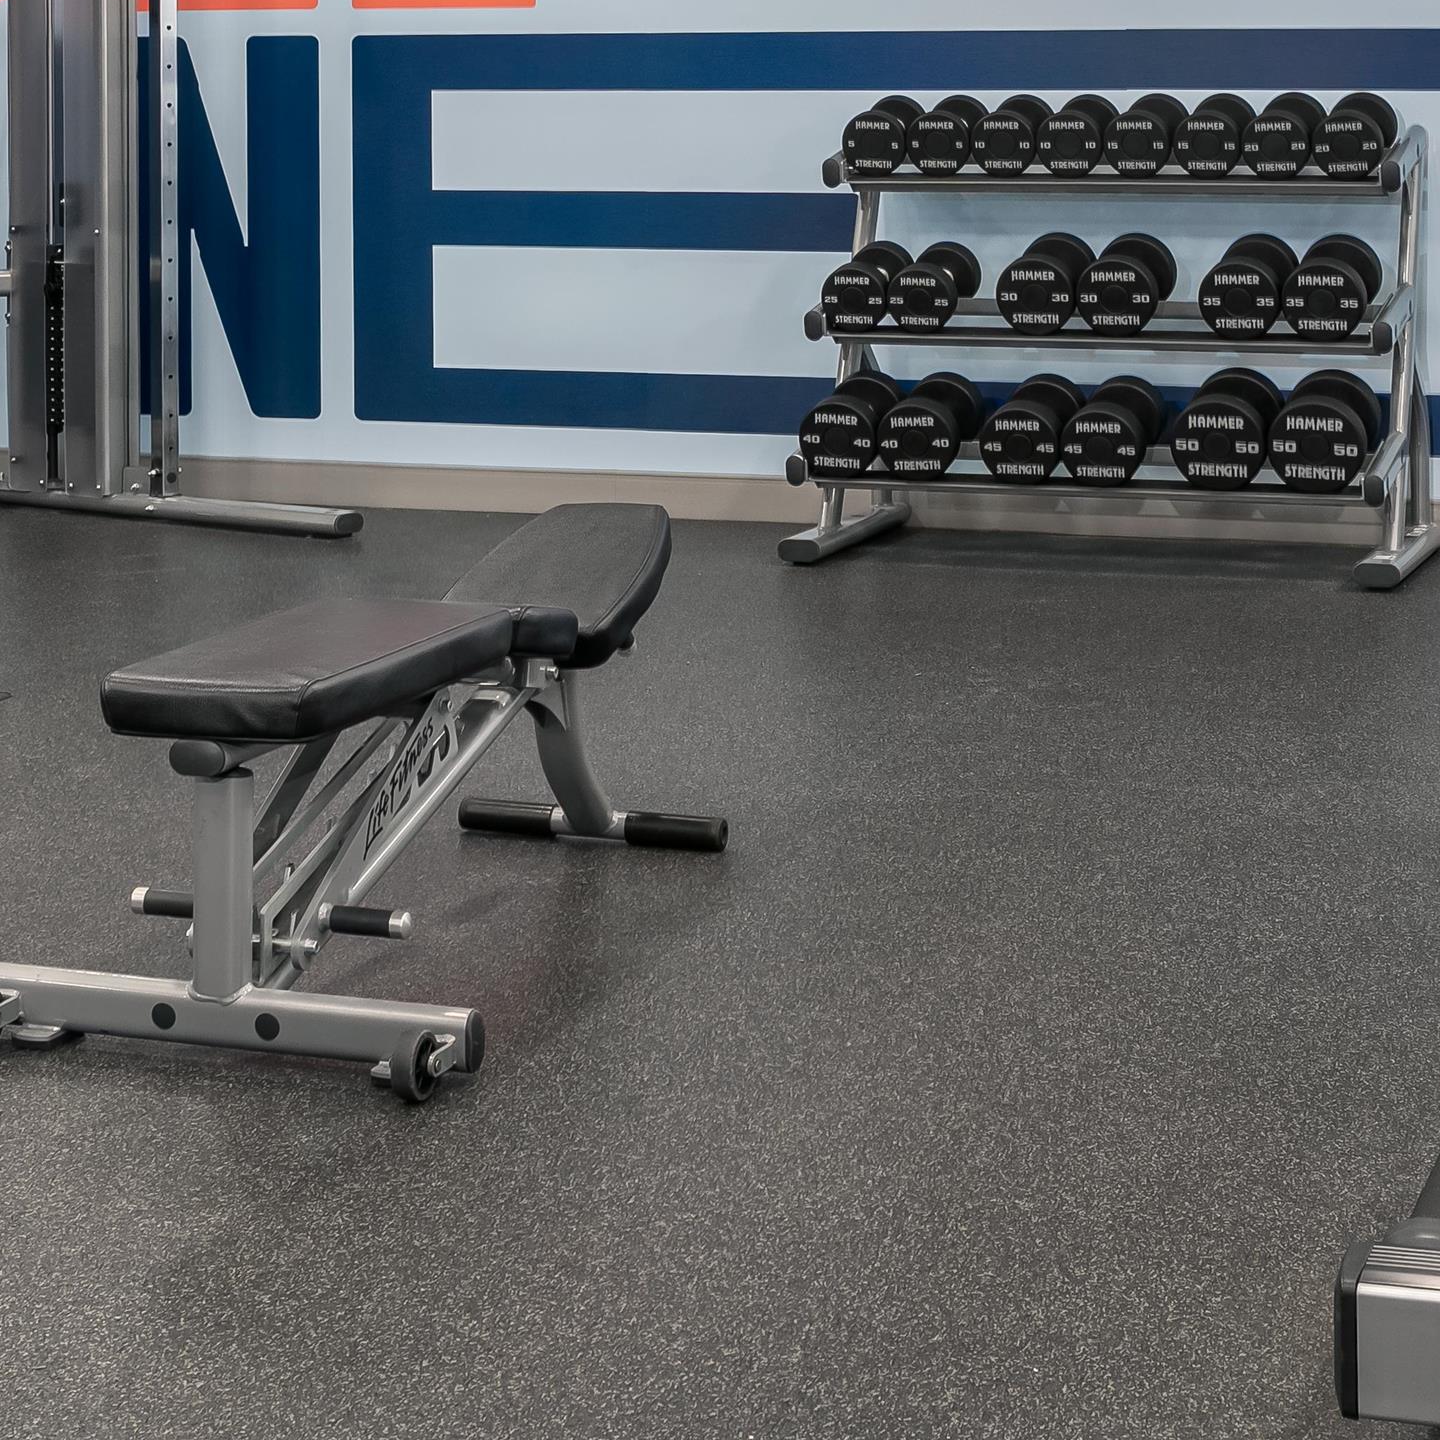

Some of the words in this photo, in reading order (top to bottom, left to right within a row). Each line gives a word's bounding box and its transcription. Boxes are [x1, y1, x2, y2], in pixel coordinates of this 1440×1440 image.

[855, 120, 890, 130] HAMMER
[918, 121, 954, 131] HAMMER
[983, 121, 1019, 130] HAMMER
[1048, 121, 1085, 131] HAMMER
[1116, 121, 1153, 131] HAMMER
[1187, 121, 1225, 131] HAMMER
[1254, 122, 1292, 133] HAMMER
[1324, 122, 1363, 133] HAMMER
[847, 140, 855, 148] 5
[891, 142, 899, 150] 5
[911, 140, 920, 148] 5
[955, 141, 963, 149] 5
[974, 141, 986, 149] 10
[1019, 141, 1030, 149] 10
[1040, 141, 1051, 150] 10
[1085, 141, 1096, 149] 10
[1107, 141, 1119, 150] 15
[1152, 141, 1164, 150] 15
[1177, 141, 1189, 150] 15
[1224, 142, 1236, 151] 15
[1244, 144, 1259, 152] 20
[1291, 142, 1306, 151] 20
[1315, 144, 1330, 153] 20
[1362, 142, 1377, 150] 20
[855, 159, 893, 170] STRENGTH
[919, 159, 957, 169] STRENGTH
[984, 160, 1023, 170] STRENGTH
[1049, 160, 1089, 170] STRENGTH
[1117, 161, 1157, 171] STRENGTH
[1187, 161, 1228, 172] STRENGTH
[1256, 161, 1297, 173] STRENGTH
[1327, 162, 1369, 173] STRENGTH
[833, 274, 870, 286] HAMMER
[1011, 270, 1055, 282] HAMMER
[1090, 271, 1136, 283] HAMMER
[1214, 274, 1260, 286] HAMMER
[1297, 275, 1344, 287] HAMMER
[900, 276, 936, 287] HAMMER
[823, 295, 838, 304] 25
[868, 297, 883, 305] 25
[889, 296, 904, 305] 25
[1000, 292, 1018, 301] 30
[1051, 293, 1069, 303] 30
[1080, 294, 1098, 303] 30
[1132, 294, 1150, 303] 30
[1203, 297, 1221, 306] 35
[934, 298, 949, 307] 25
[1256, 297, 1275, 307] 35
[1286, 298, 1305, 307] 35
[1340, 299, 1359, 309] 35
[835, 314, 873, 325] STRENGTH
[900, 316, 939, 326] STRENGTH
[1011, 313, 1060, 325] STRENGTH
[1091, 315, 1140, 327] STRENGTH
[1215, 318, 1265, 329] STRENGTH
[1298, 319, 1348, 331] STRENGTH
[814, 412, 858, 426] HAMMER
[890, 416, 934, 429] HAMMER
[1188, 415, 1244, 430] HAMMER
[994, 419, 1040, 432] HAMMER
[1075, 422, 1121, 434] HAMMER
[1286, 416, 1344, 433] HAMMER
[802, 434, 821, 444] 40
[853, 438, 871, 448] 40
[880, 439, 898, 449] 40
[932, 439, 950, 448] 40
[983, 442, 1002, 452] 45
[1036, 443, 1054, 453] 45
[1064, 444, 1082, 454] 45
[1175, 439, 1199, 451] 50
[1235, 442, 1259, 454] 50
[1272, 440, 1297, 453] 50
[1117, 446, 1136, 456] 45
[1333, 444, 1358, 457] 50
[814, 455, 860, 469] STRENGTH
[894, 459, 941, 471] STRENGTH
[996, 464, 1045, 476] STRENGTH
[1076, 466, 1125, 478] STRENGTH
[1187, 463, 1248, 479] STRENGTH
[1284, 465, 1346, 482] STRENGTH
